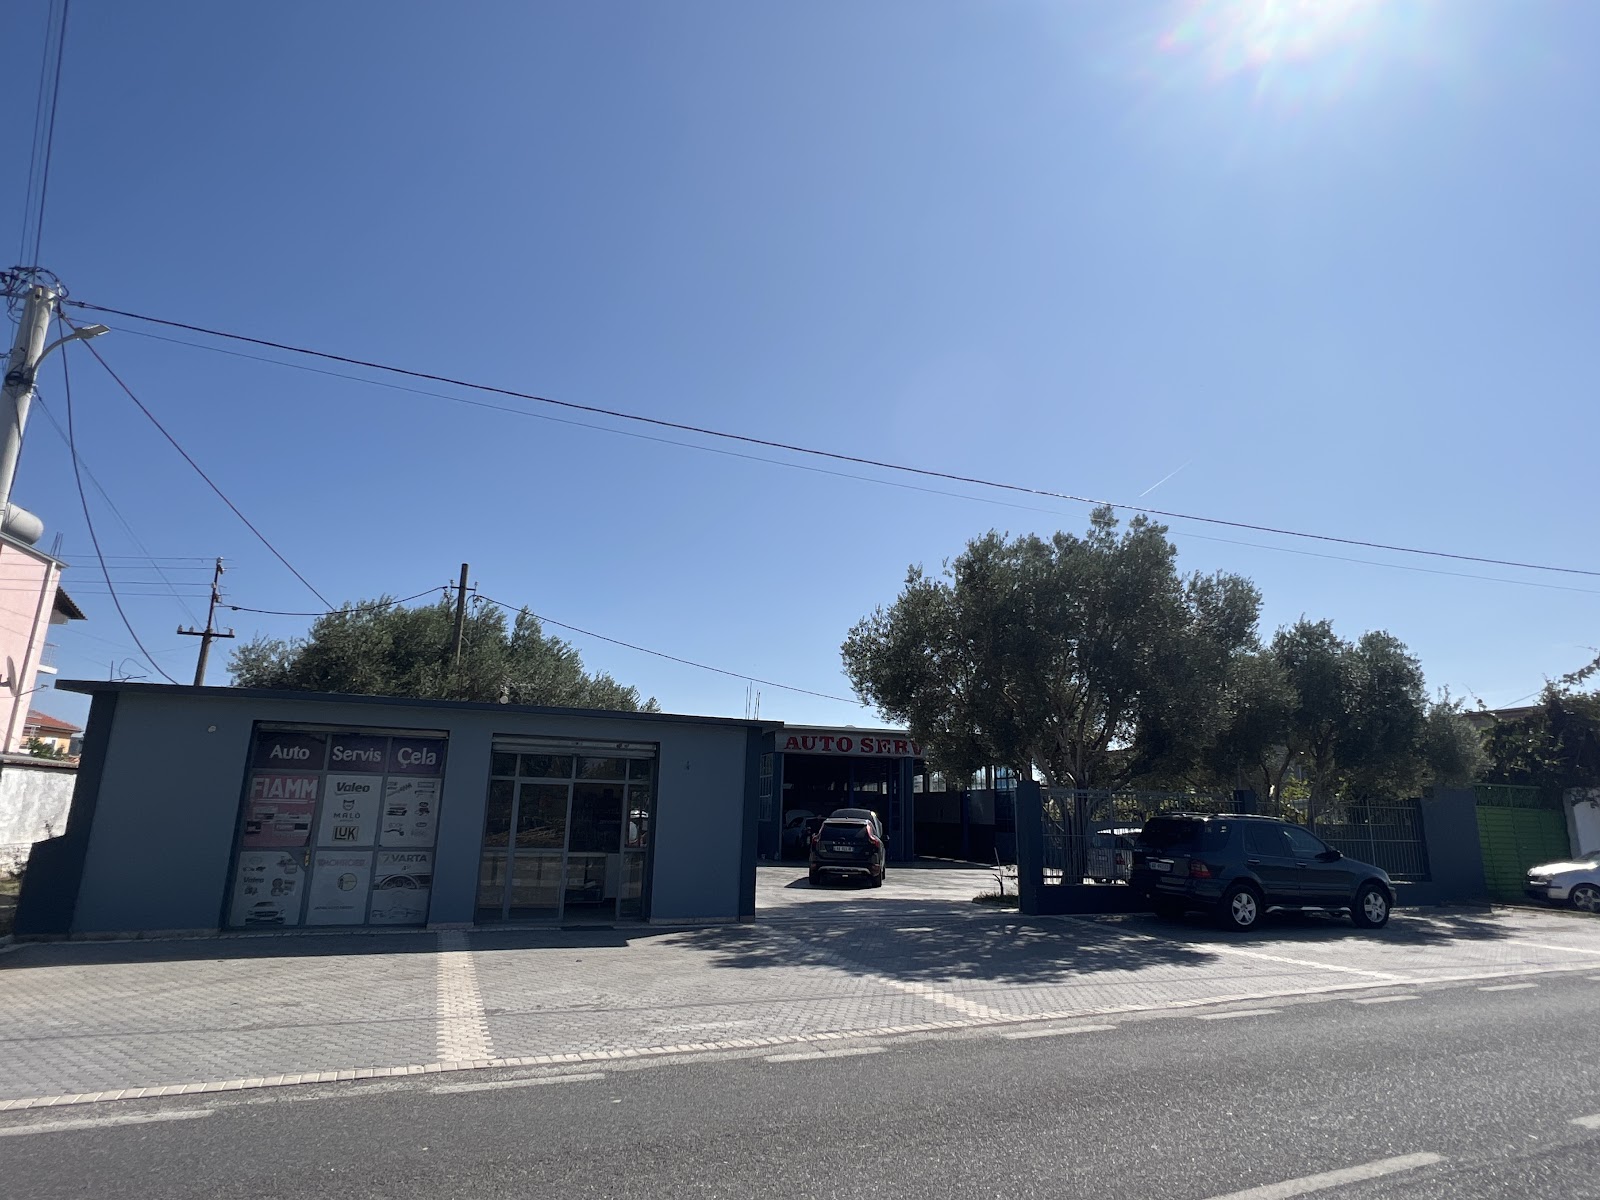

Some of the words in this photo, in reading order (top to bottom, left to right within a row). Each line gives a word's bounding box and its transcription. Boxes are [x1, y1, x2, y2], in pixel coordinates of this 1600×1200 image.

[784, 736, 853, 752] AUTO
[269, 744, 310, 759] Auto
[332, 745, 382, 762] Servis
[397, 748, 436, 768] Çela
[250, 777, 318, 799] FIAMM
[336, 782, 371, 793] Valeo
[391, 854, 427, 863] VARTA
